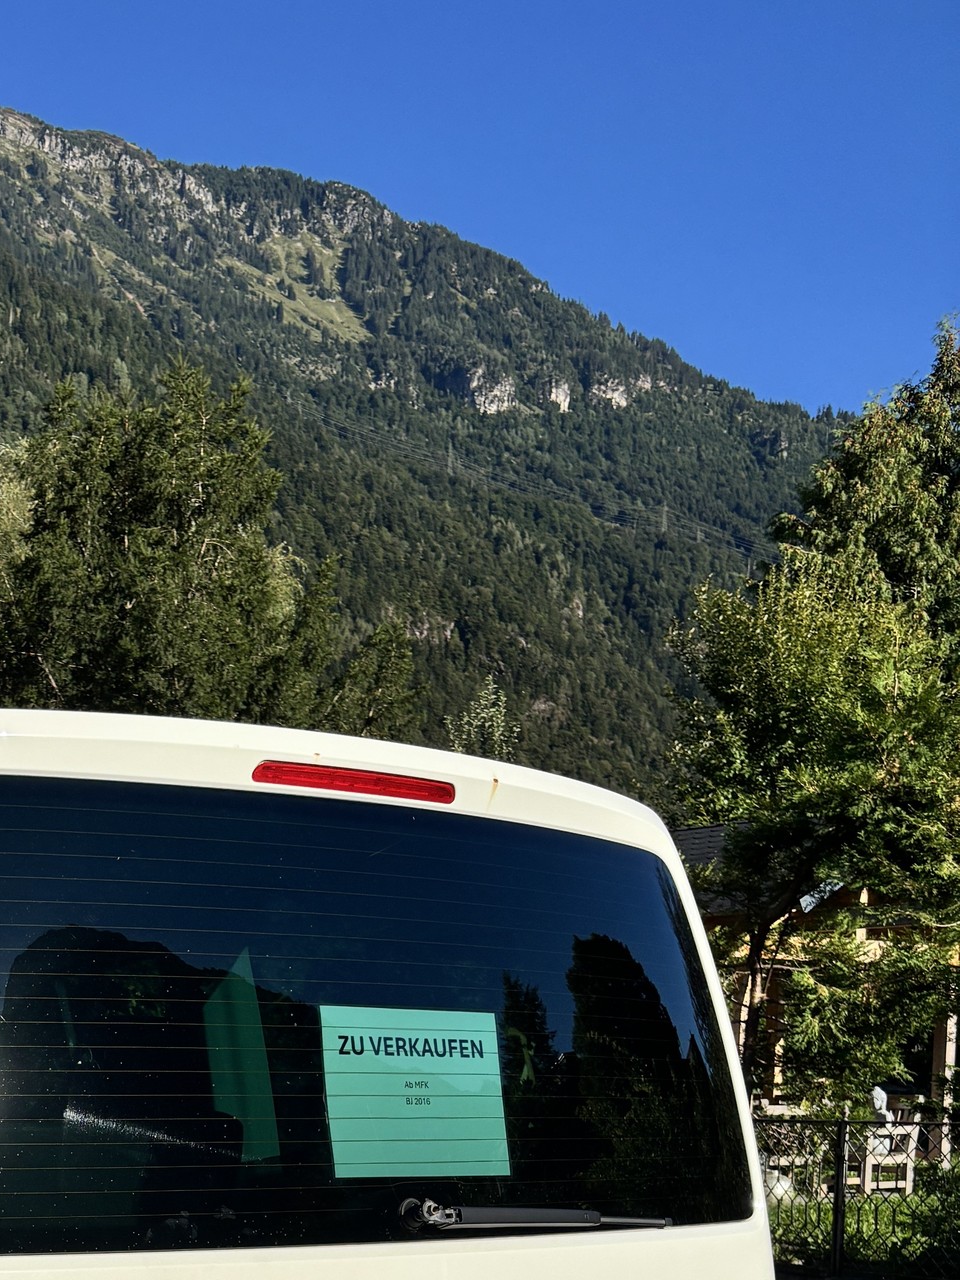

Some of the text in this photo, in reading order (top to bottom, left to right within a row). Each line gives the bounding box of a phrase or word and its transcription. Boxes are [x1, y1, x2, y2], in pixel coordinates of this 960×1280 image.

[337, 1034, 485, 1059] ZU VERKAUFEN
[404, 1081, 429, 1089] Ab MFK
[414, 1097, 431, 1106] 2016
